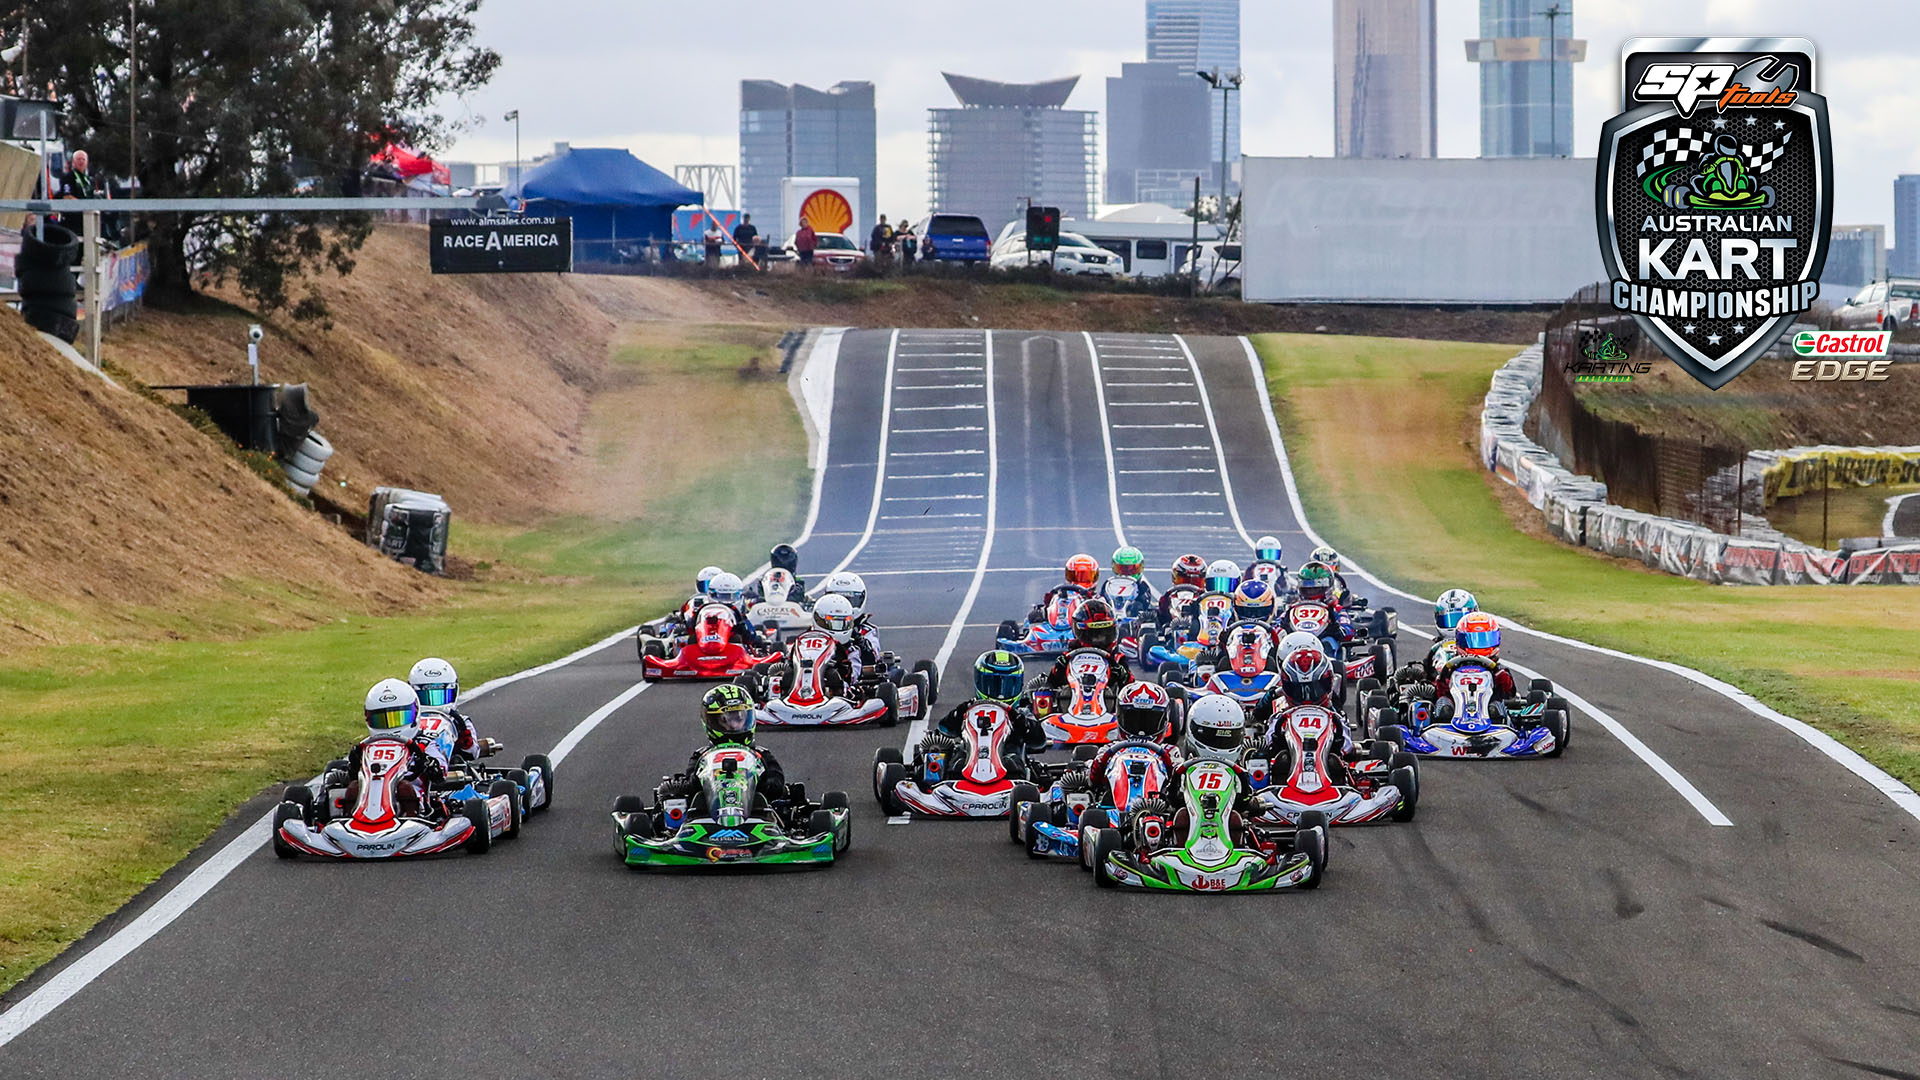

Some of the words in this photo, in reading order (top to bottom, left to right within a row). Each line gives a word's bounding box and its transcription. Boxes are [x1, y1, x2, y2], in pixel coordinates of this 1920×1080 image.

[1299, 609, 1320, 618] 37
[804, 639, 823, 649] 16
[975, 710, 997, 724] 11
[1299, 717, 1322, 729] 44
[373, 749, 396, 760] 95
[1198, 773, 1223, 789] 15
